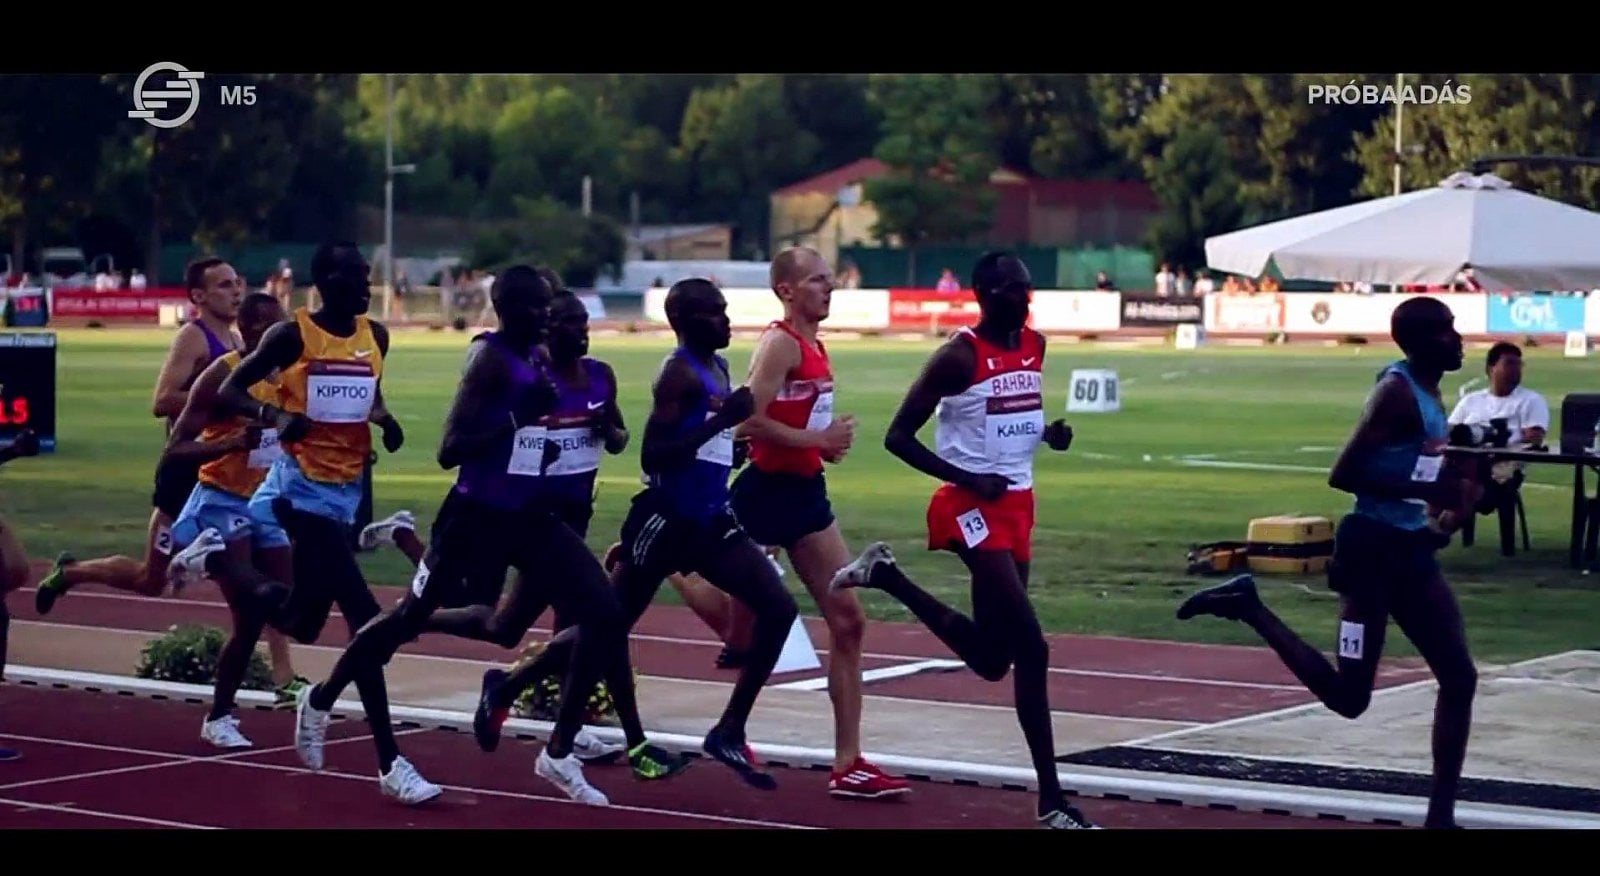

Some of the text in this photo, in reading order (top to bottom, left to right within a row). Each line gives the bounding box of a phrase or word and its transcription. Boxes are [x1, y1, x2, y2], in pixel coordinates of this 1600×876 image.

[316, 385, 369, 399] KIPTOO
[1075, 378, 1099, 401] 60
[997, 422, 1038, 437] KAMEL
[964, 516, 984, 536] 13
[160, 532, 169, 549] 2
[1342, 637, 1360, 653] 11
